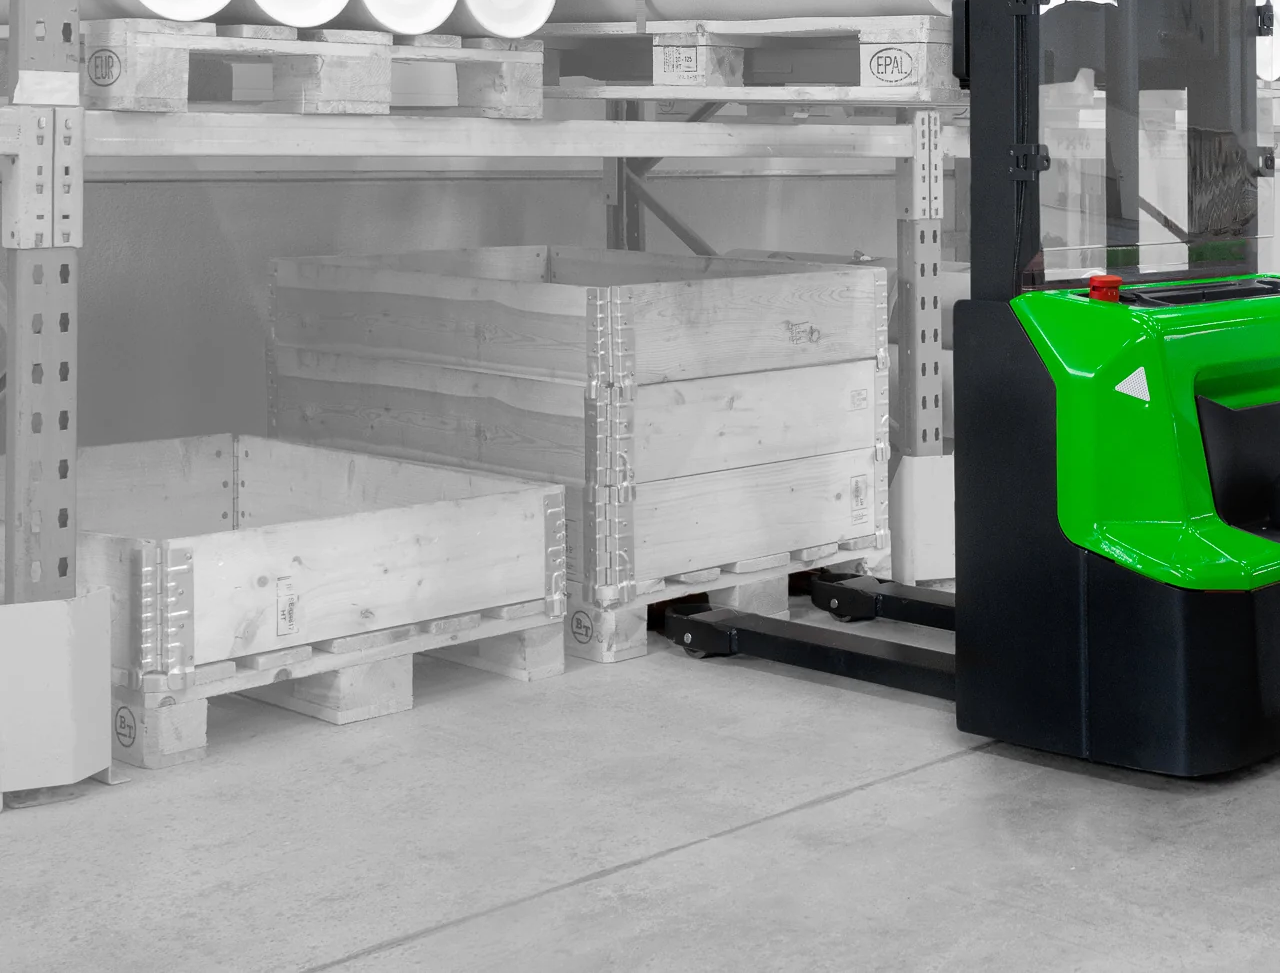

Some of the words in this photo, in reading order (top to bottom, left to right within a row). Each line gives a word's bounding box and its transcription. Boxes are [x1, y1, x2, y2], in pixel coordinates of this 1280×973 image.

[94, 55, 114, 80] EUR
[876, 55, 908, 74] EPAL
[575, 617, 591, 637] BT
[119, 714, 134, 739] BT
